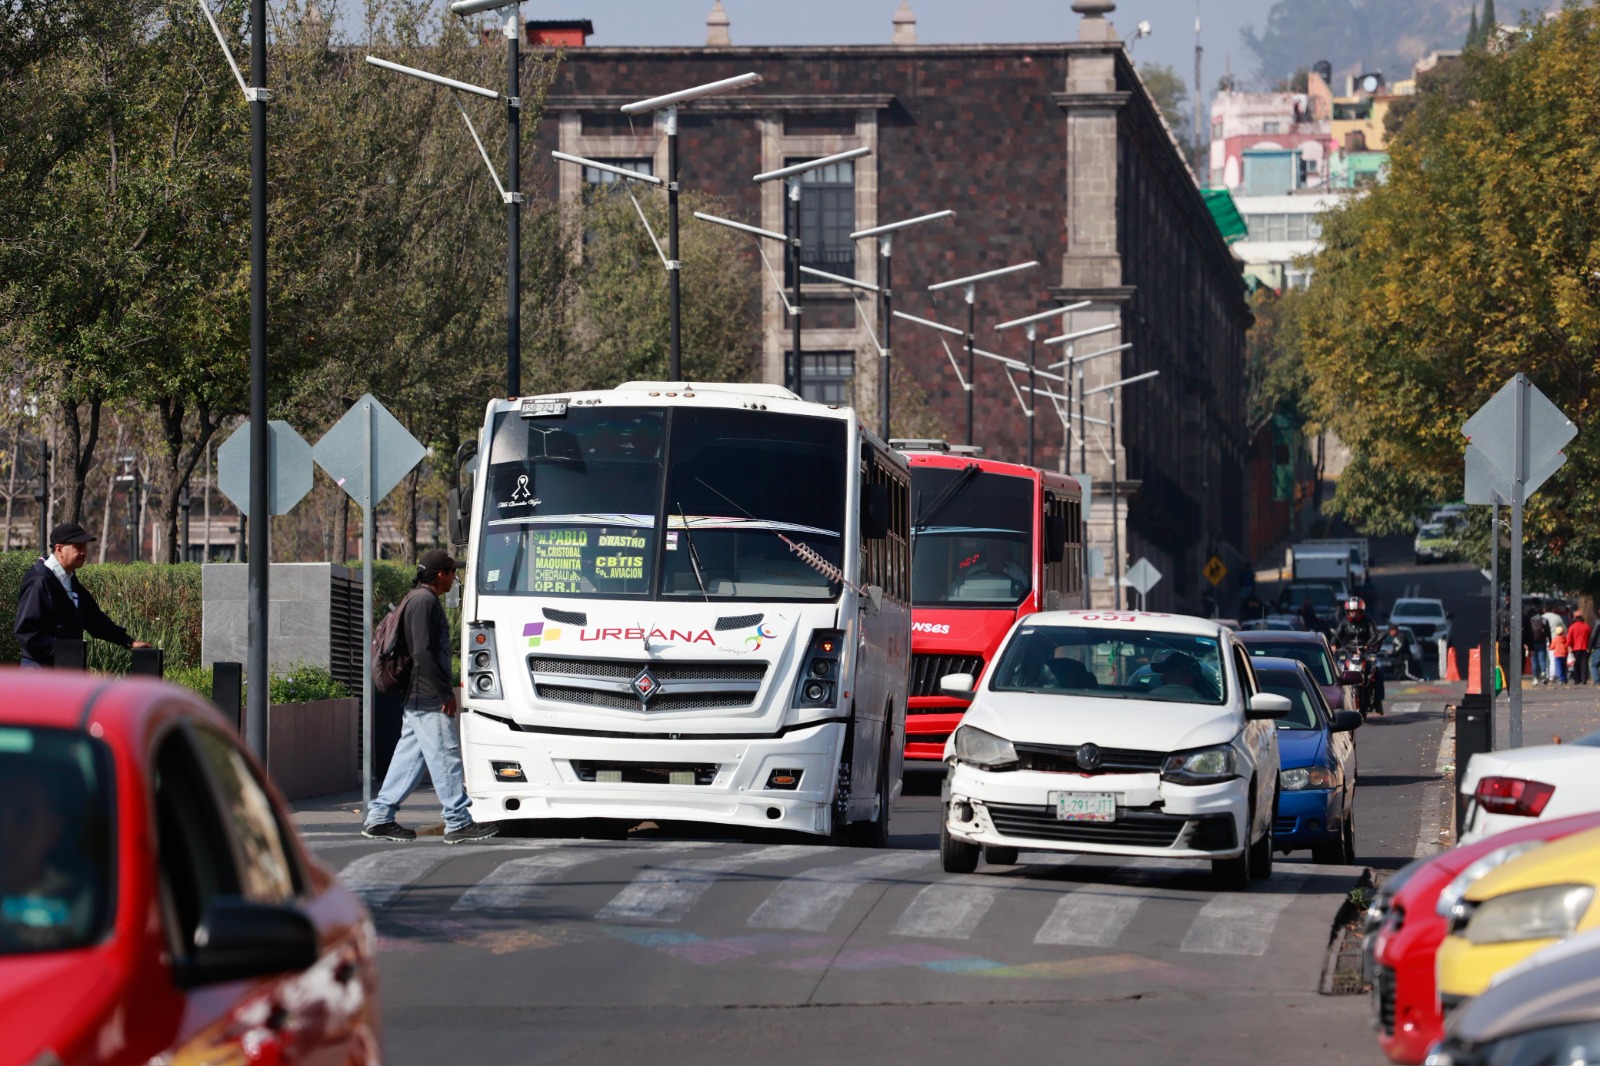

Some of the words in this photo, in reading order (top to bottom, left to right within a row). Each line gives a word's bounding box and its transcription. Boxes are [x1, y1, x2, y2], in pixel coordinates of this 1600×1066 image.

[535, 557, 581, 571] MAQUINITA
[595, 556, 643, 567] CBTIS
[579, 626, 716, 646] URBANA
